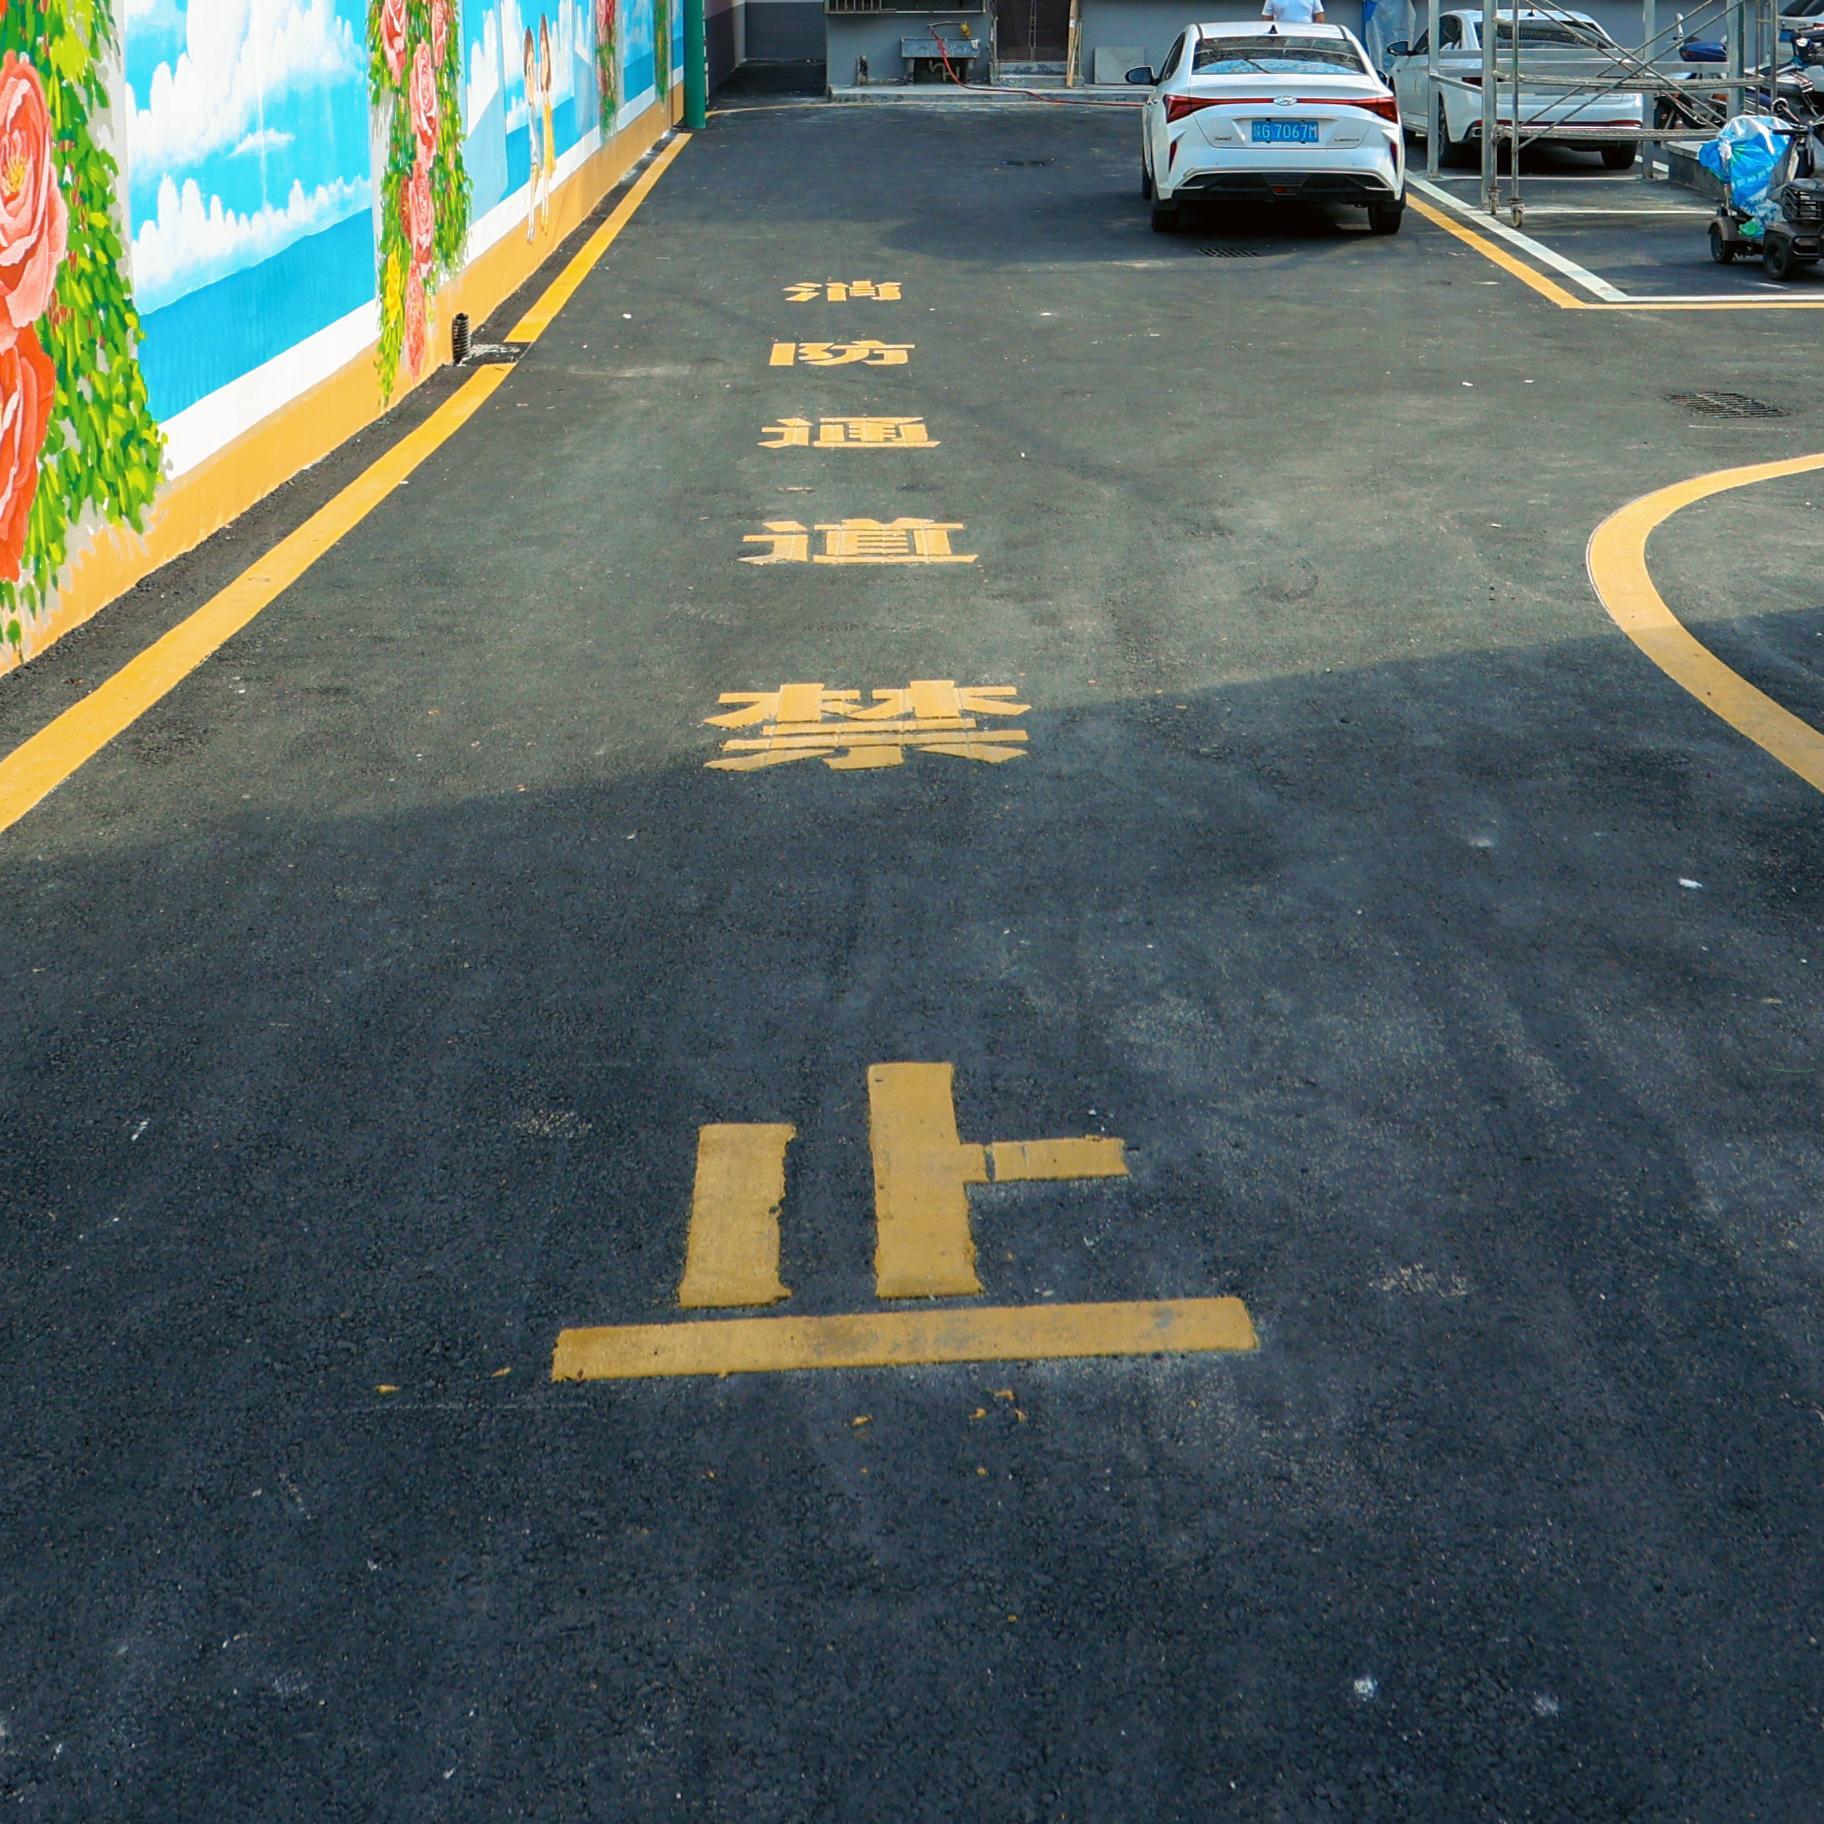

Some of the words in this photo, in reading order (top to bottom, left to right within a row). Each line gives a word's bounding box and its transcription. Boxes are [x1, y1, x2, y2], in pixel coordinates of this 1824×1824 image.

[550, 280, 1259, 1382] 消防通道禁止
